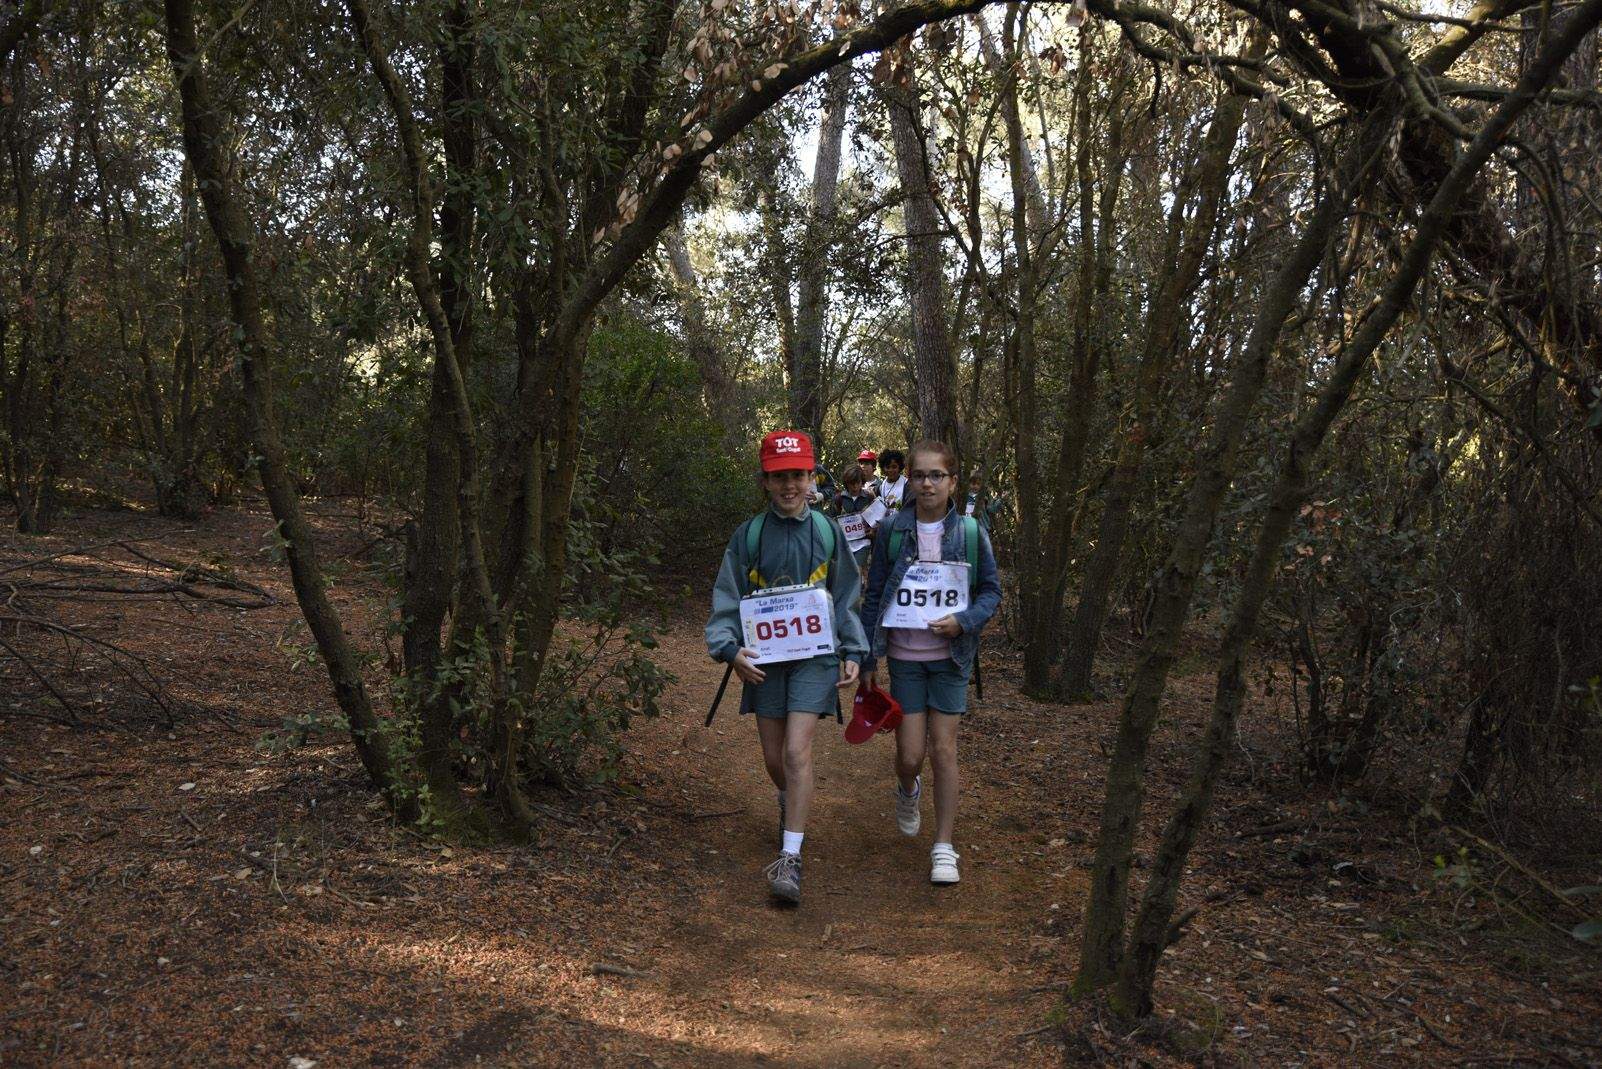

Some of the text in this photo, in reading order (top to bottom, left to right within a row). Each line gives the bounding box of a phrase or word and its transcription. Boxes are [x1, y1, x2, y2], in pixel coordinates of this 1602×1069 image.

[775, 437, 799, 448] TOT
[770, 597, 794, 606] Marxa
[896, 588, 959, 607] 0518
[756, 615, 822, 641] 0518
